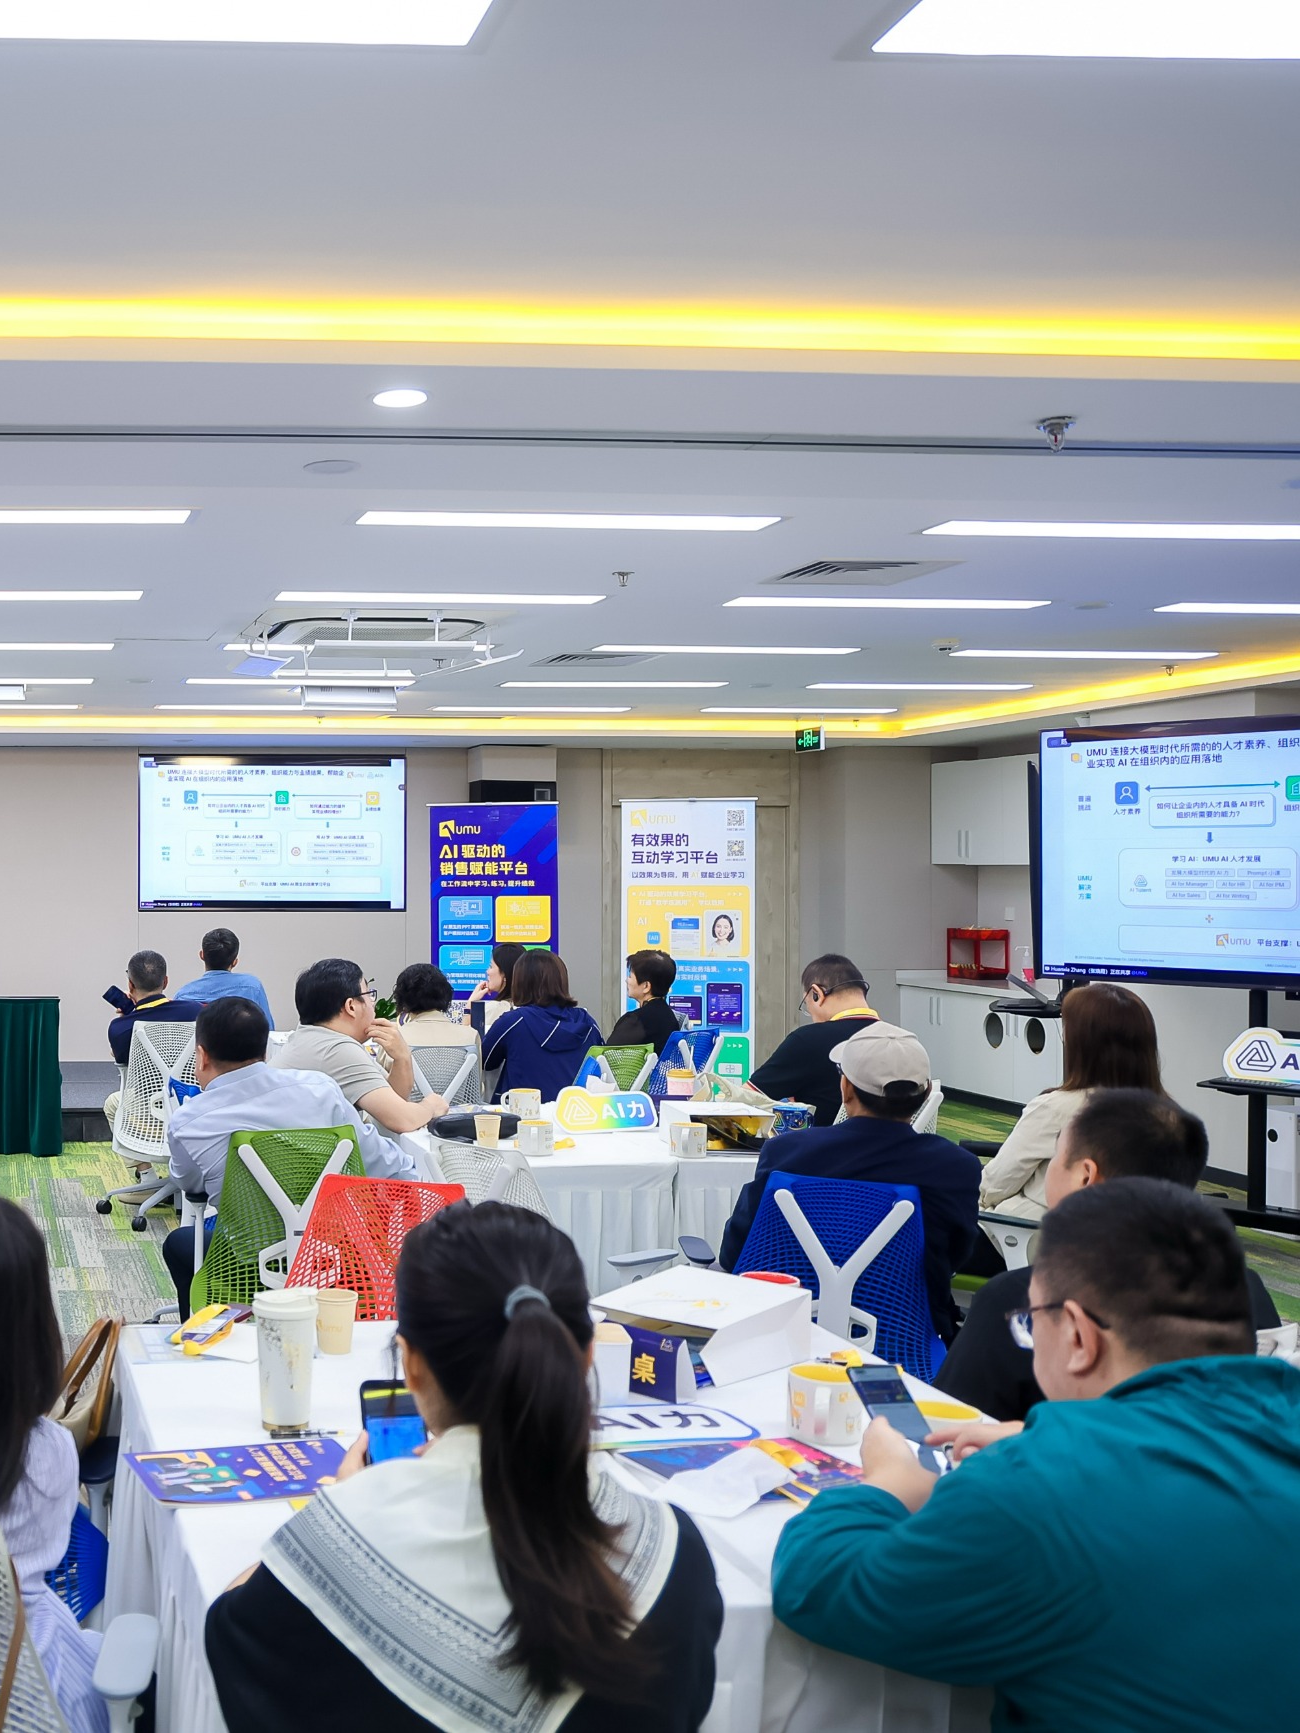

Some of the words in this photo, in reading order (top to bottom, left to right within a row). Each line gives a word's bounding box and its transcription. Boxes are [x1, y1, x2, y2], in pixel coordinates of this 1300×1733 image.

[1086, 748, 1108, 757] UMU
[1086, 758, 1116, 769] 业实现
[1117, 758, 1127, 767] AI
[1130, 753, 1223, 767] 在组织内的应用落地
[1249, 800, 1265, 808] 时代
[648, 815, 676, 824] umu
[455, 825, 481, 834] umu
[631, 833, 689, 847] 有效果的
[439, 844, 458, 859] AI
[461, 844, 506, 858] 驱动的
[631, 850, 718, 864] 互动学习平台
[1172, 855, 1186, 863] 学习
[1230, 855, 1261, 863] 人才发展
[440, 861, 528, 876] 销售赋能平台
[691, 871, 699, 879] AI
[700, 871, 745, 879] 赋能企业学习
[637, 917, 647, 925] AI
[1230, 938, 1251, 946] umu
[602, 1101, 646, 1120] AI力
[632, 1353, 656, 1385] 桌
[592, 1410, 721, 1431] AI力
